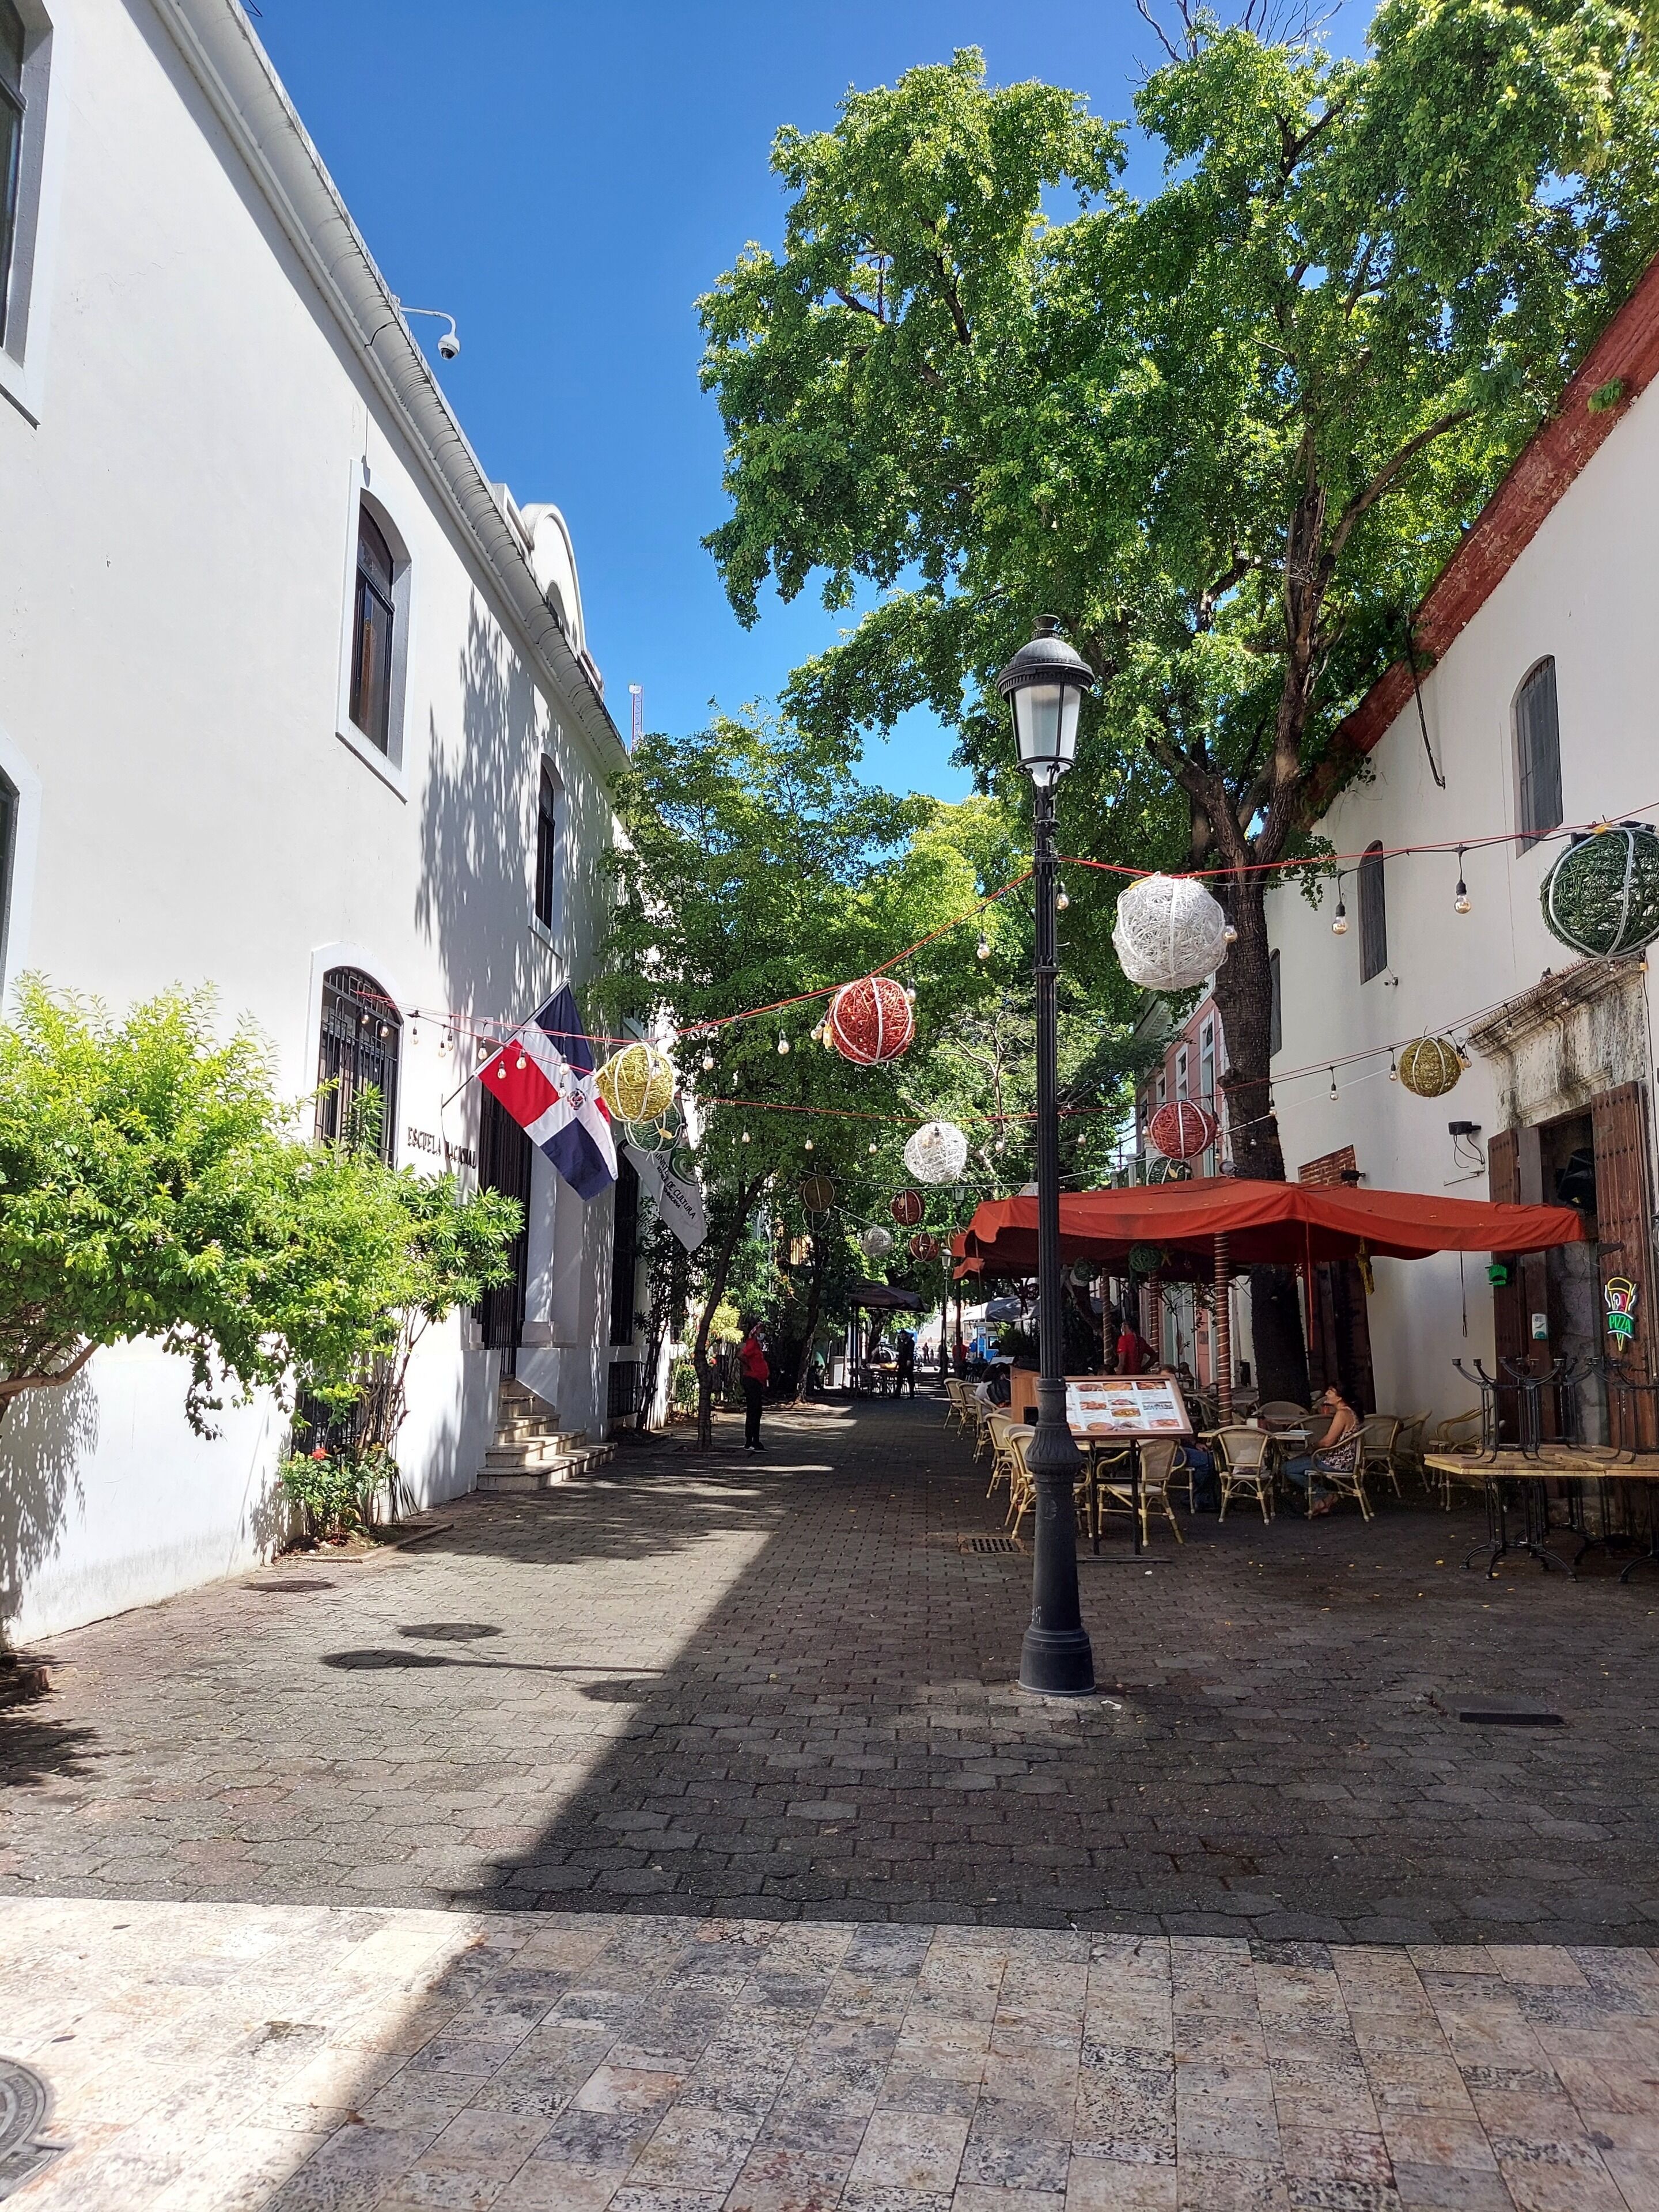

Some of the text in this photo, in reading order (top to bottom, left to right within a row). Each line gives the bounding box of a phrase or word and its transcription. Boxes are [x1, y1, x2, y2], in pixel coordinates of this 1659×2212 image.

[407, 1126, 441, 1157] ESCUELA
[666, 1181, 676, 1191] DE
[673, 1189, 696, 1219] CULTURA
[1609, 1315, 1631, 1333] PIZZA
